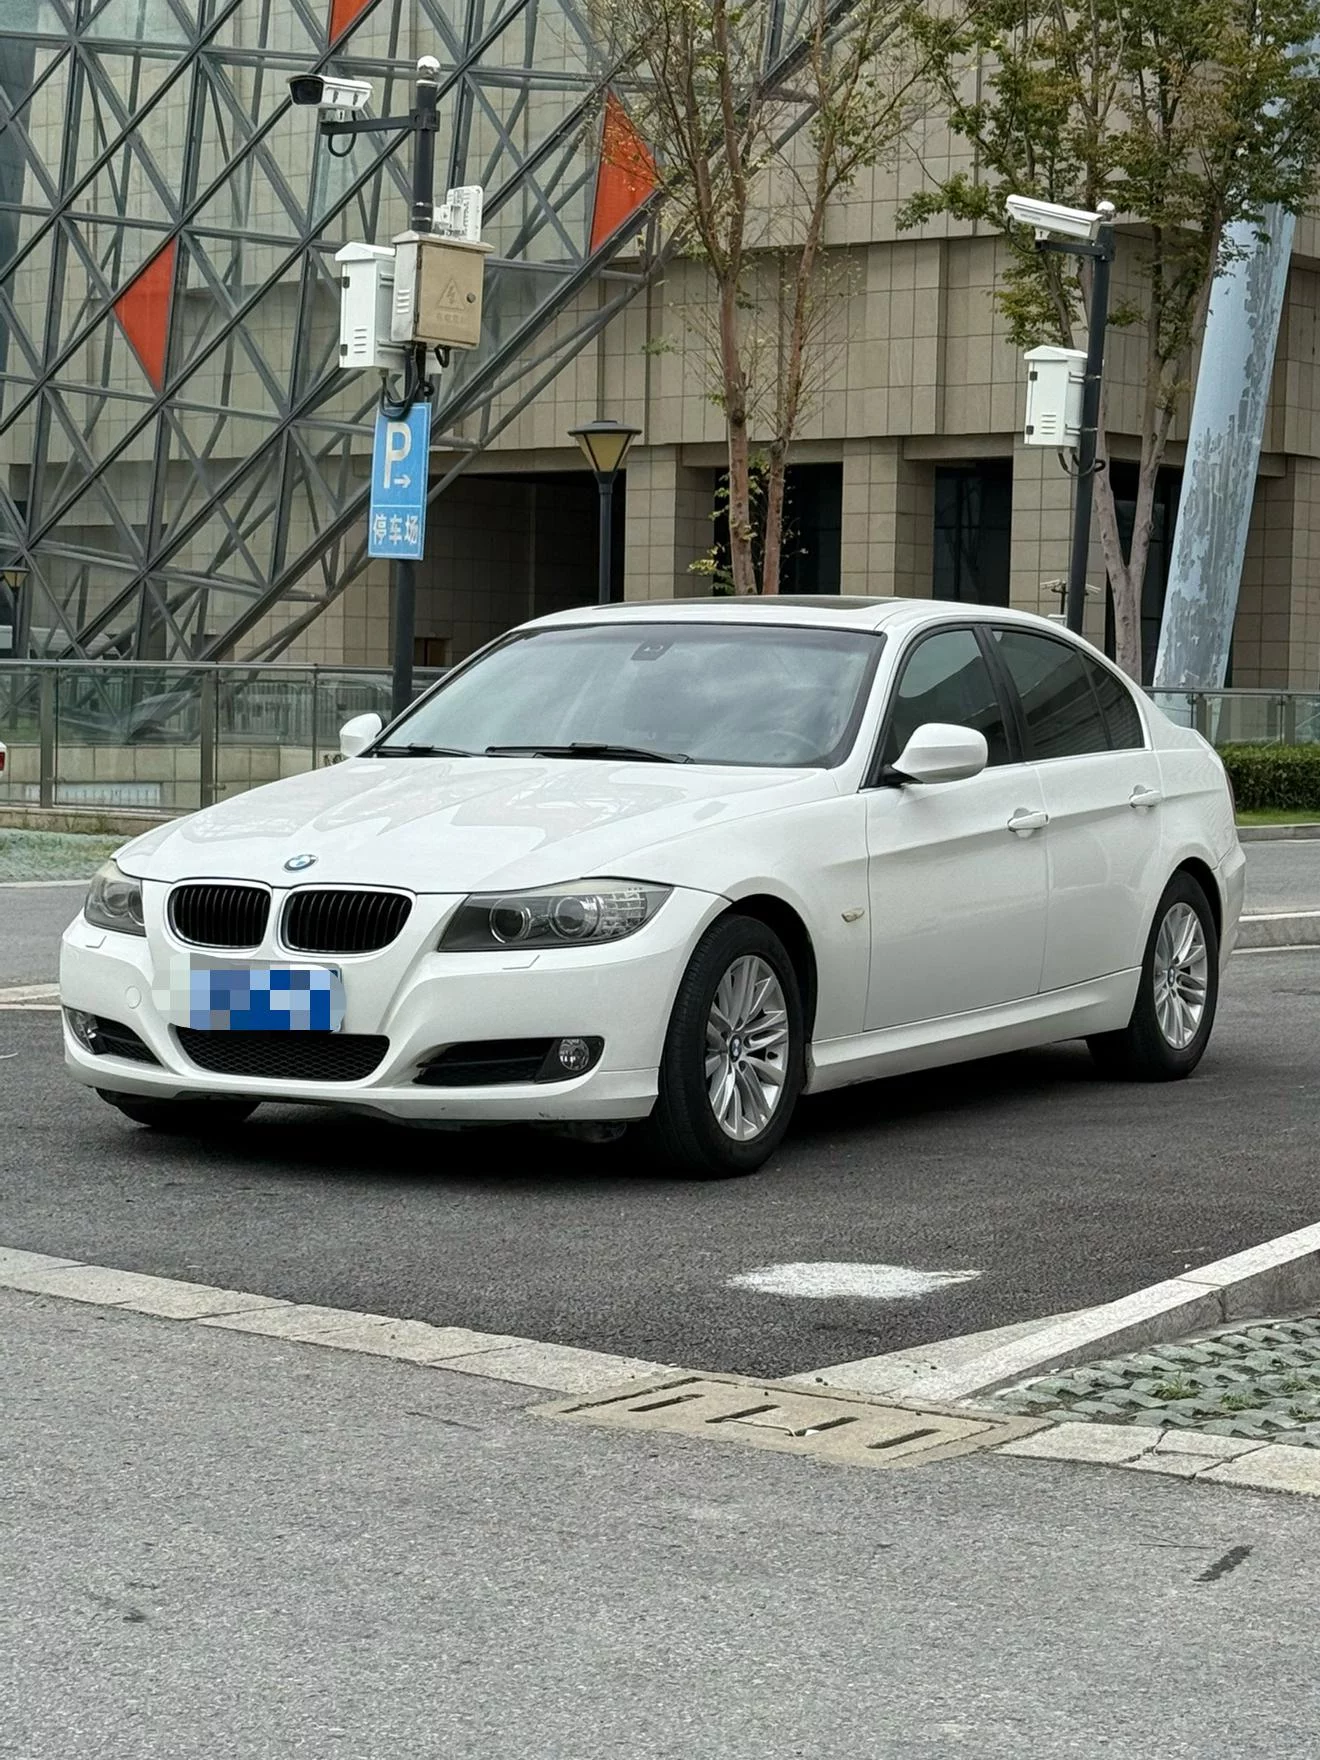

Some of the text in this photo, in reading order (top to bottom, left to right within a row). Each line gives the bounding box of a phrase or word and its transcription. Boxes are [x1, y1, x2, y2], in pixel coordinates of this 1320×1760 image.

[383, 421, 412, 489] P
[373, 513, 419, 546] 停车场
